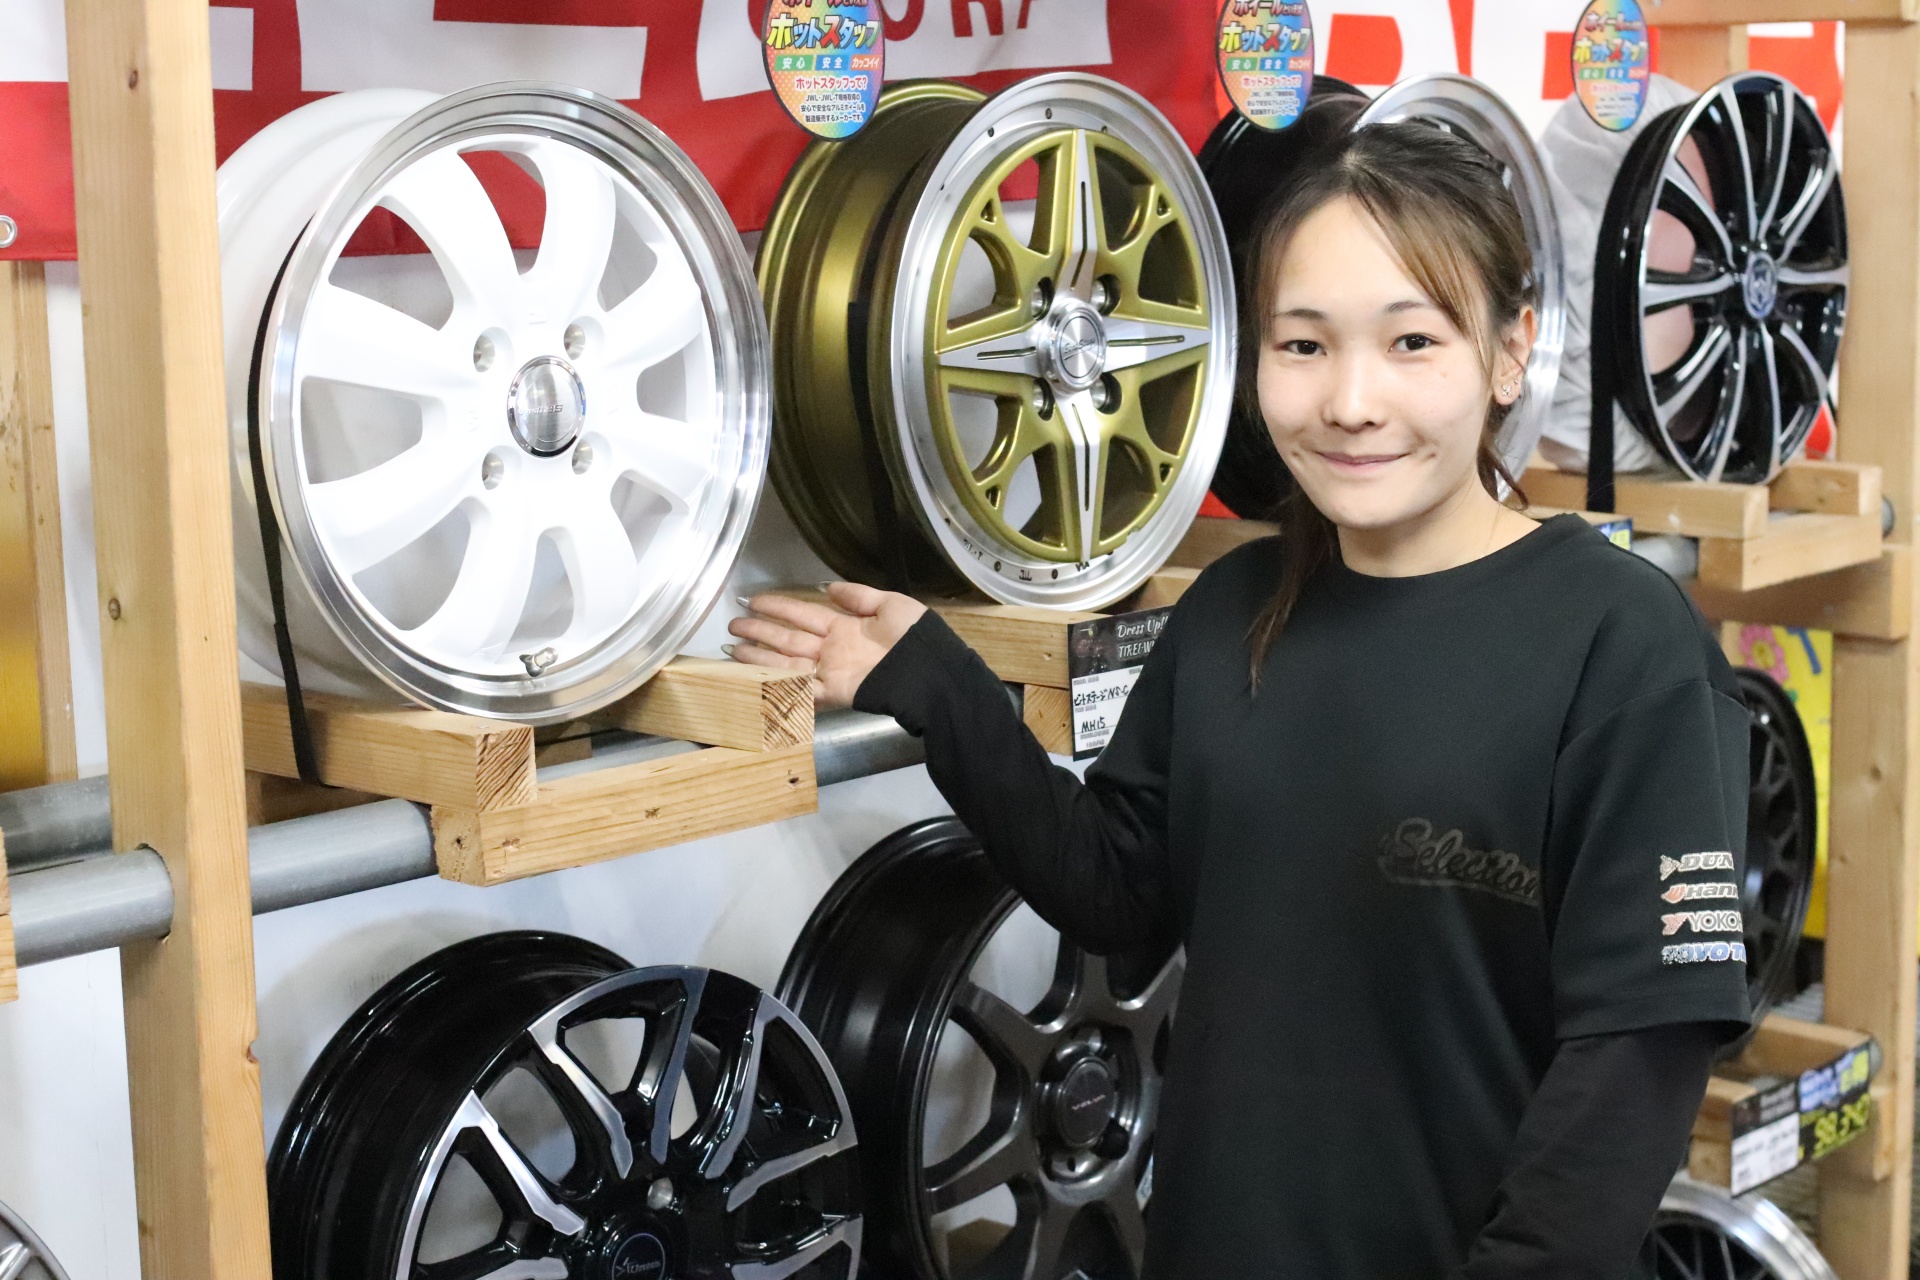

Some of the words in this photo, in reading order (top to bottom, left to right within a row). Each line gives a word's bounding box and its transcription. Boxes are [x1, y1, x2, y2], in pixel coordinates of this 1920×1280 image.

[766, 12, 880, 50] ホットスタッフ
[1219, 21, 1312, 53] ホットスタッフ
[782, 57, 806, 69] 安心
[822, 57, 843, 69] 安全
[1117, 624, 1145, 638] Dress
[1118, 640, 1155, 658] TIRE&W
[1081, 716, 1106, 733] MH15
